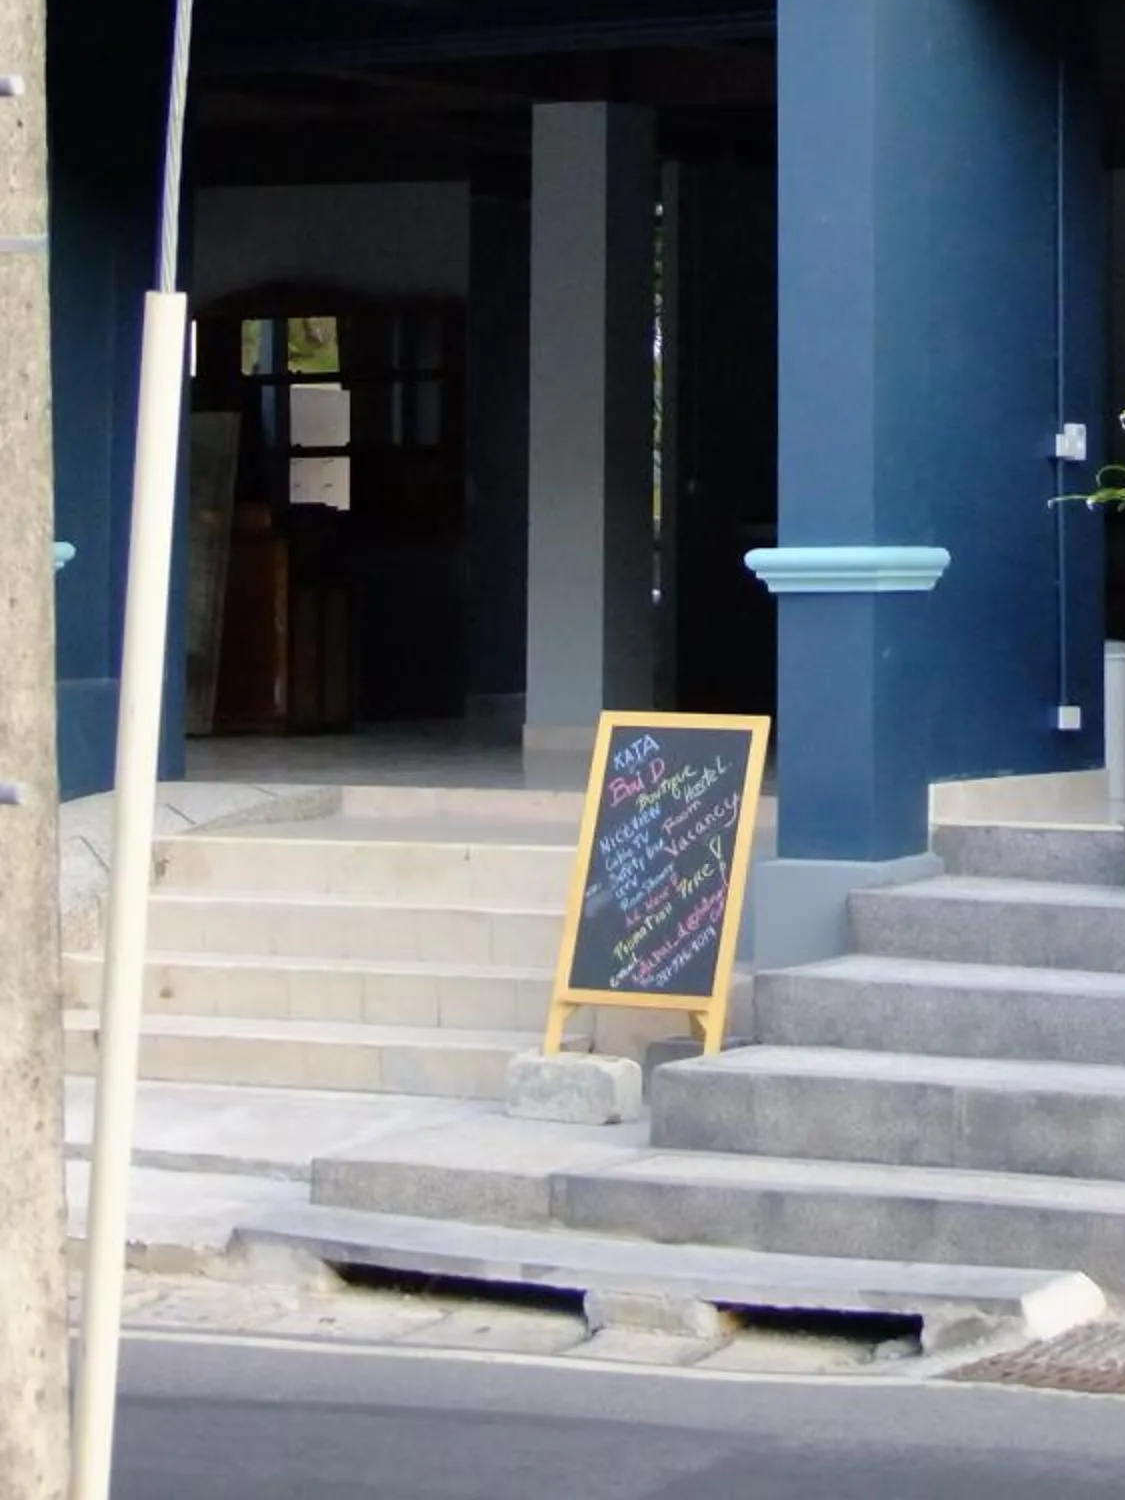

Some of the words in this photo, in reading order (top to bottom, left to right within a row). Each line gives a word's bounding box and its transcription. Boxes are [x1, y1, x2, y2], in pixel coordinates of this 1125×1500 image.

[614, 734, 659, 770] KATA
[650, 757, 665, 783] D
[665, 792, 738, 857] Vacancy
